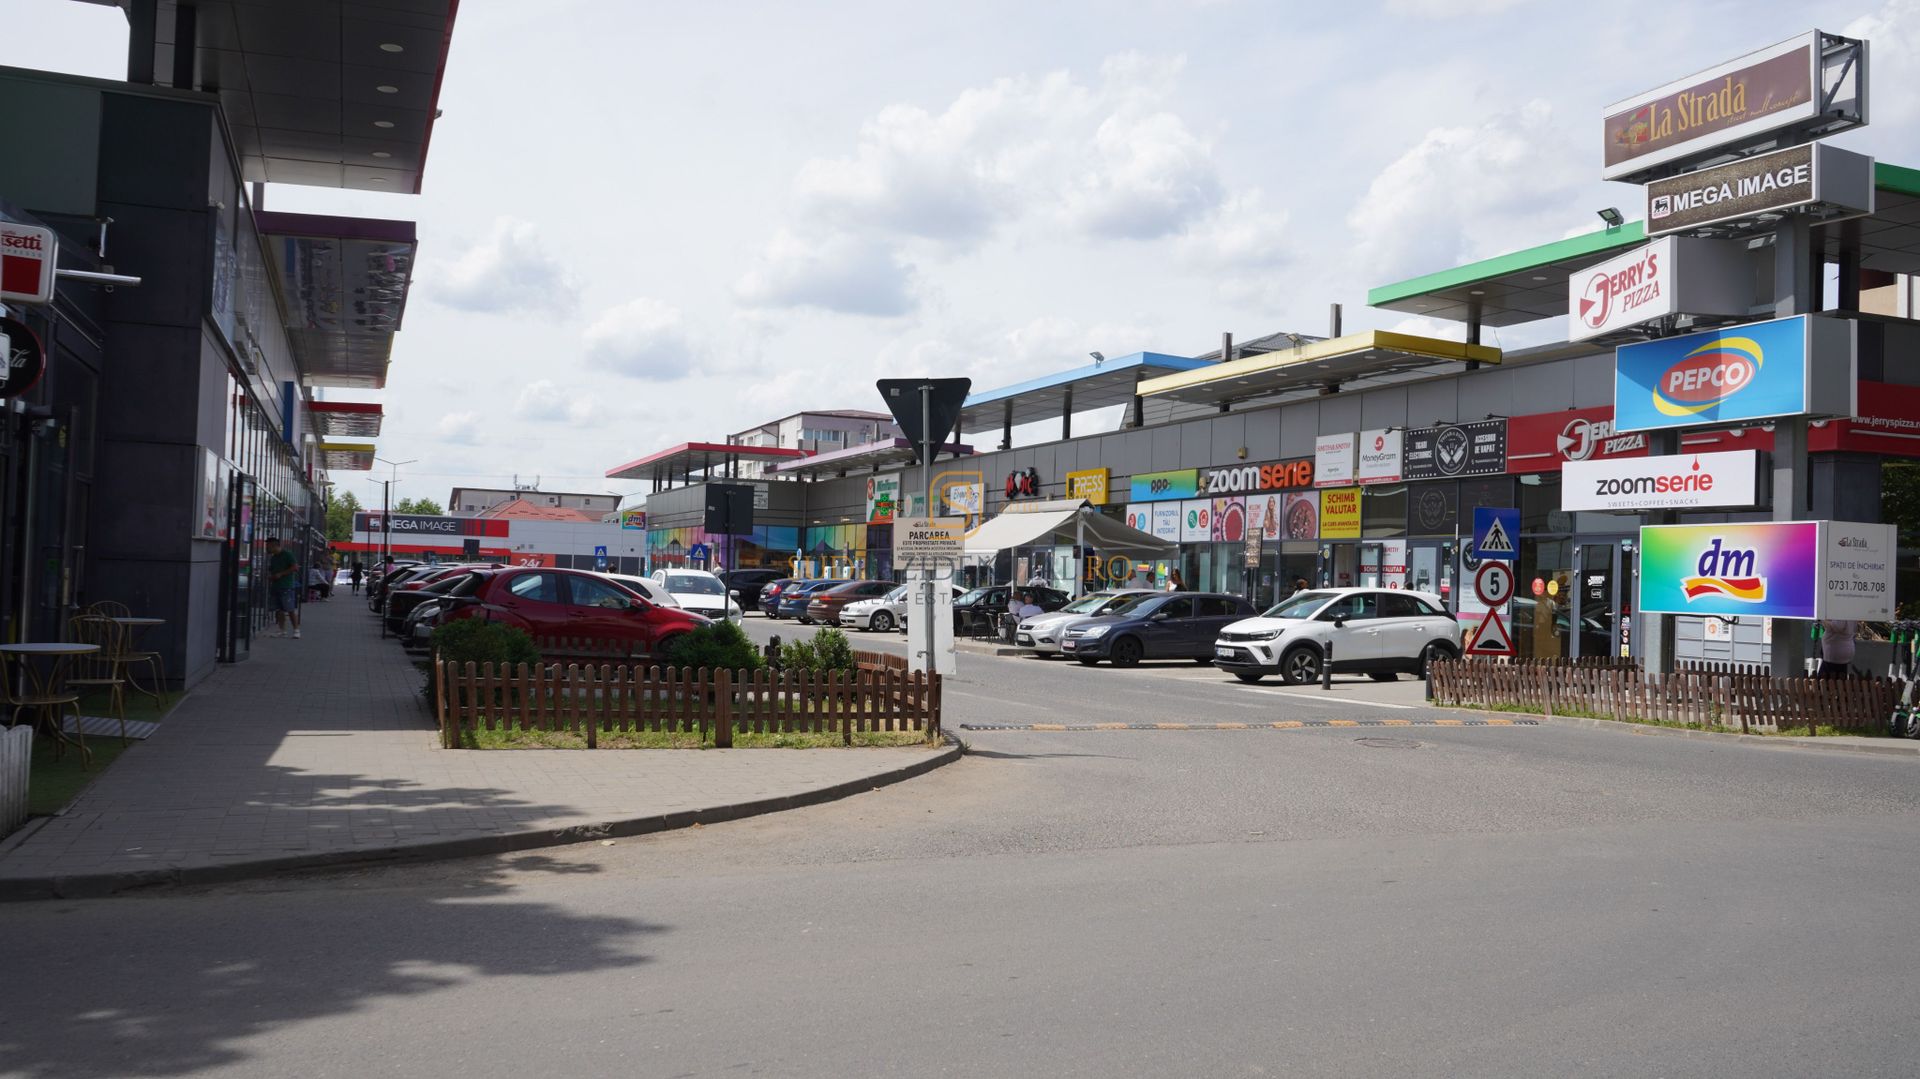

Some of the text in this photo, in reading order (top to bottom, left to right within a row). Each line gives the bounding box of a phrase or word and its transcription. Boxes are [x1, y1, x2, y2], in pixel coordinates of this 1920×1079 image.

[1650, 76, 1747, 141] La Strada
[1673, 164, 1810, 212] MEGA IMAGE
[1592, 248, 1658, 327] JERRY'S
[1622, 280, 1660, 313] PIZZA
[1669, 361, 1746, 393] PEPCO
[1603, 434, 1646, 455] PIZZA
[1361, 453, 1397, 463] MoneyGram
[1074, 474, 1103, 496] PRESS
[1207, 459, 1314, 494] zoomserie
[1595, 472, 1713, 496] zoomserie
[1327, 492, 1356, 504] SCHIMB
[627, 514, 641, 523] dm
[1325, 504, 1357, 515] VALUTAR
[420, 520, 456, 532] IMAGE
[909, 531, 950, 540] PARCAREA
[1852, 537, 1868, 548] Strada
[1698, 538, 1755, 578] dm
[1847, 562, 1856, 570] DE
[1382, 565, 1403, 573] VALUTAR
[1490, 571, 1500, 596] 5
[1828, 580, 1886, 592] 0731.708.708
